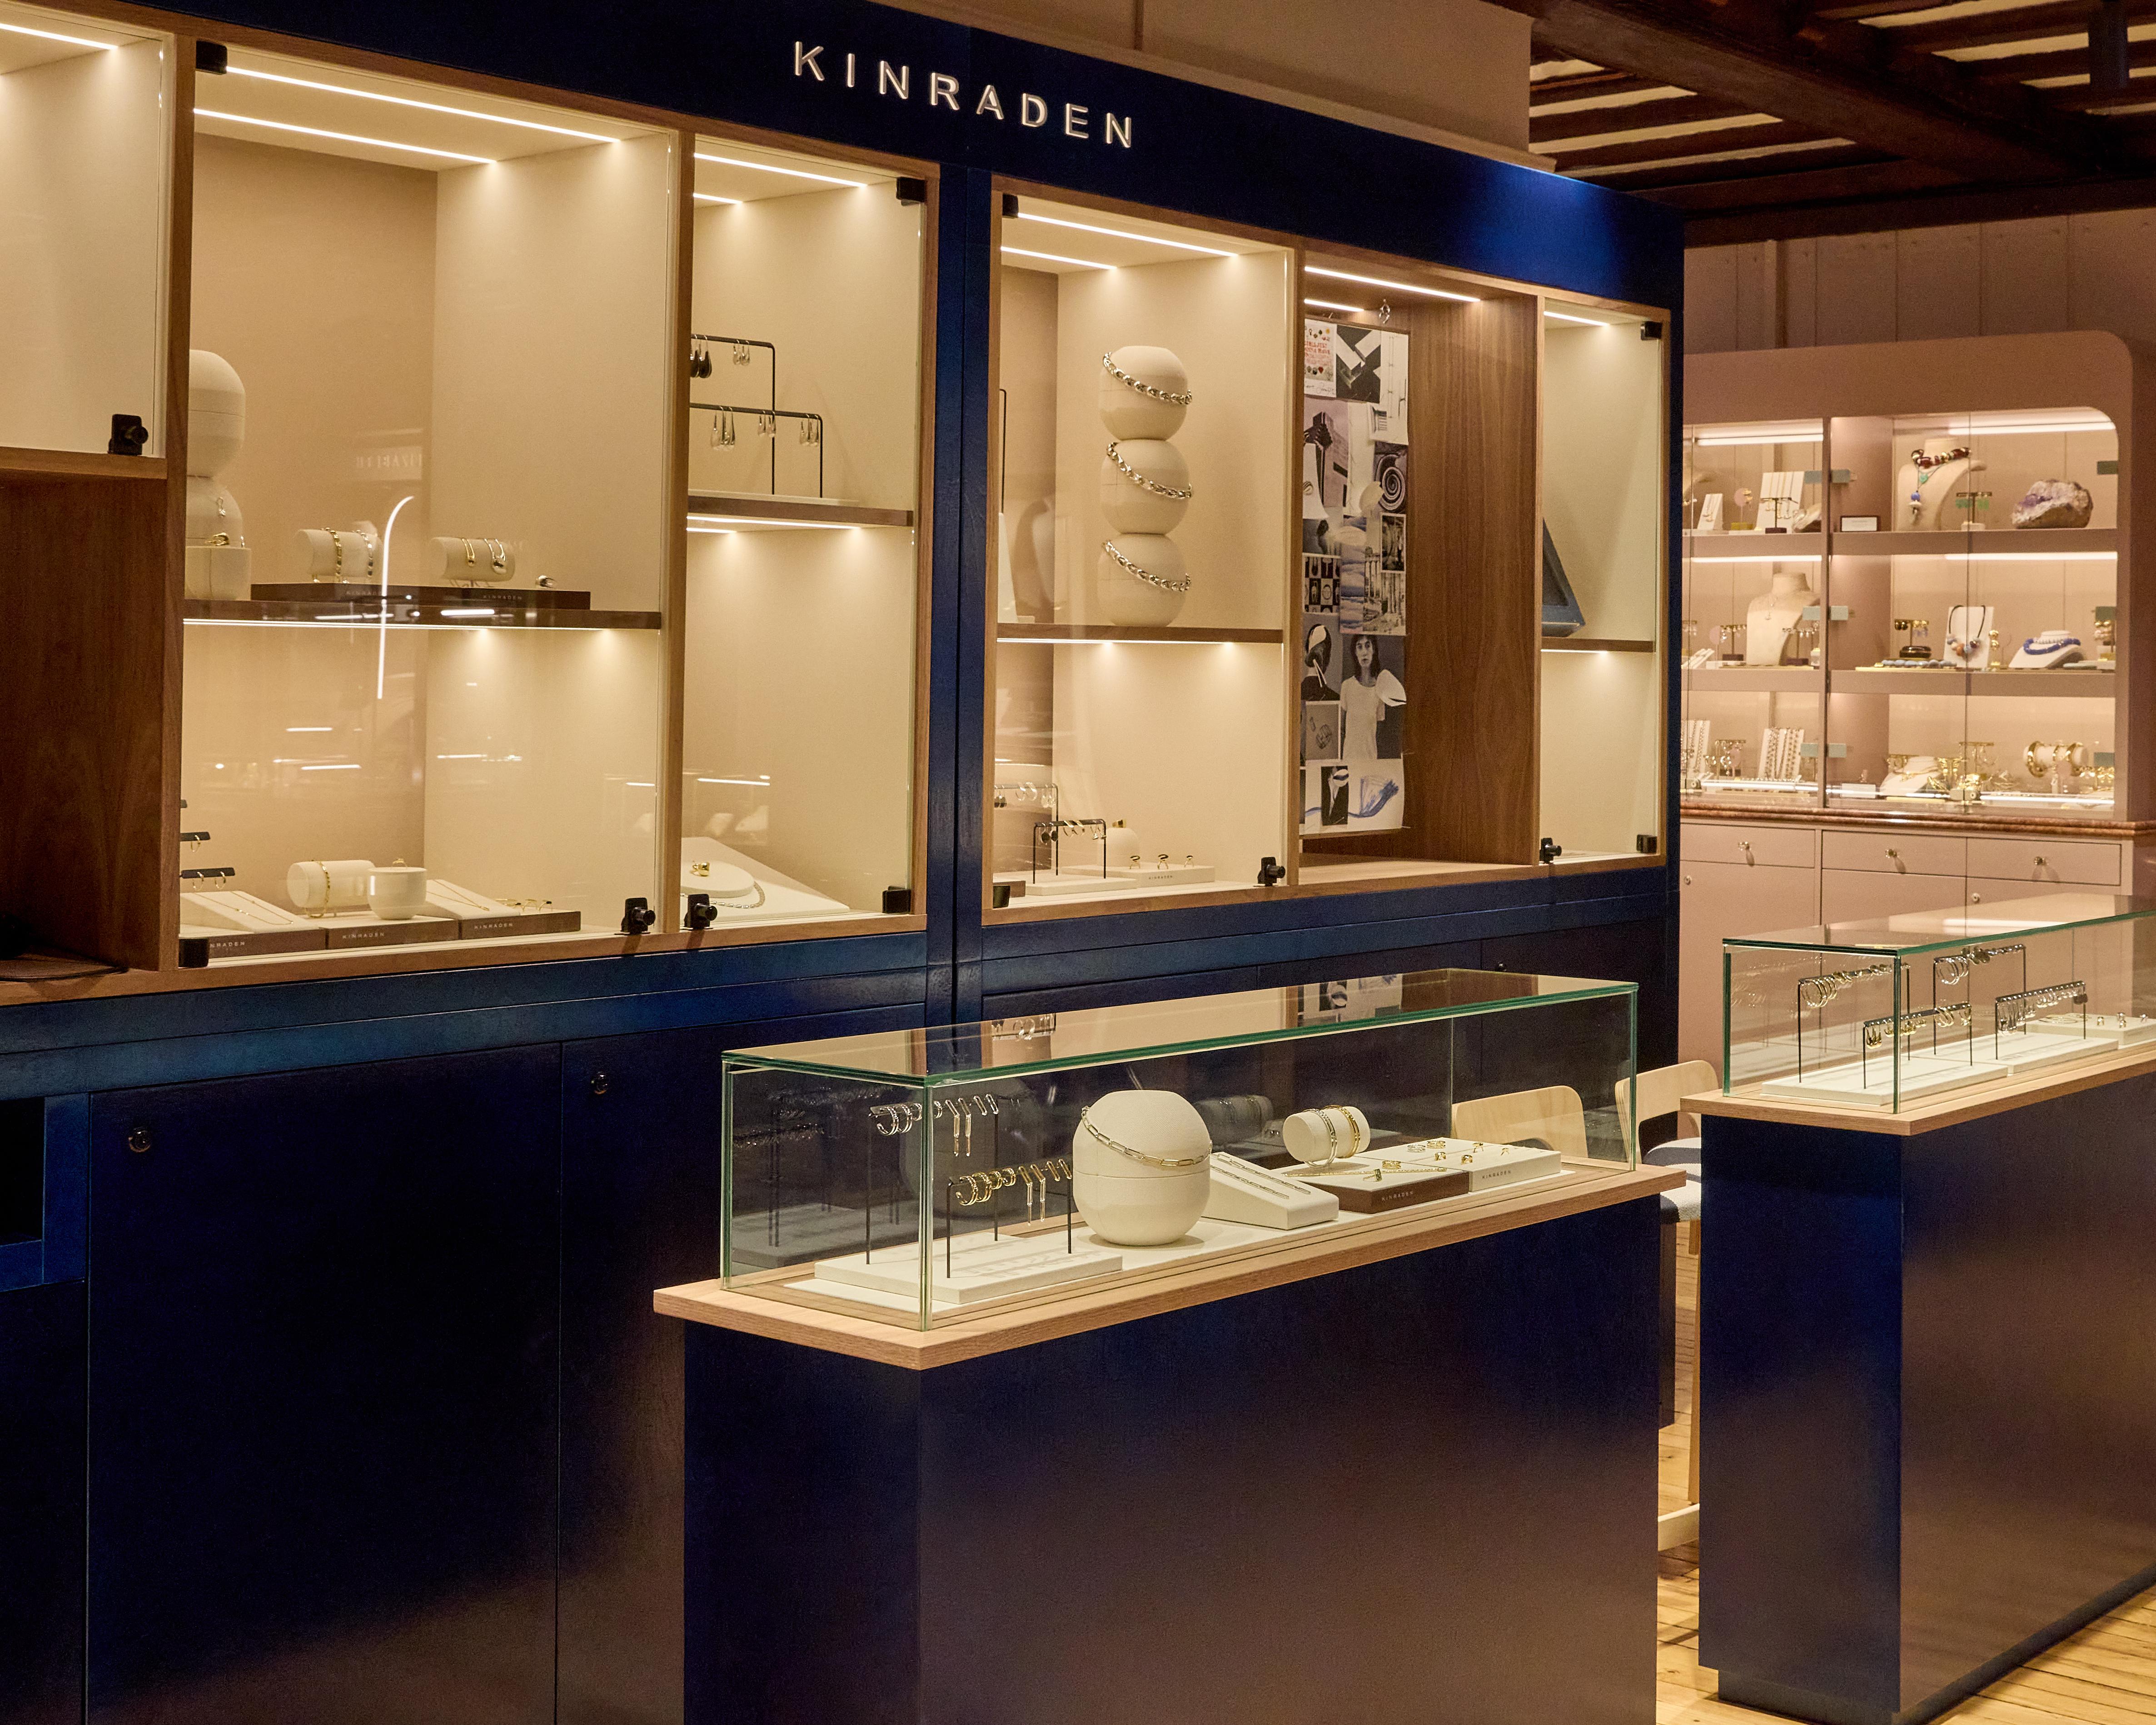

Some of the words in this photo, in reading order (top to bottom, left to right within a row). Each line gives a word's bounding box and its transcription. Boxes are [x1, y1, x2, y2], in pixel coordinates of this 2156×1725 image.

[794, 41, 1132, 148] KINRADEN
[1482, 1171, 1511, 1179] KINRADEN
[1382, 1191, 1413, 1201] KINRADEN
